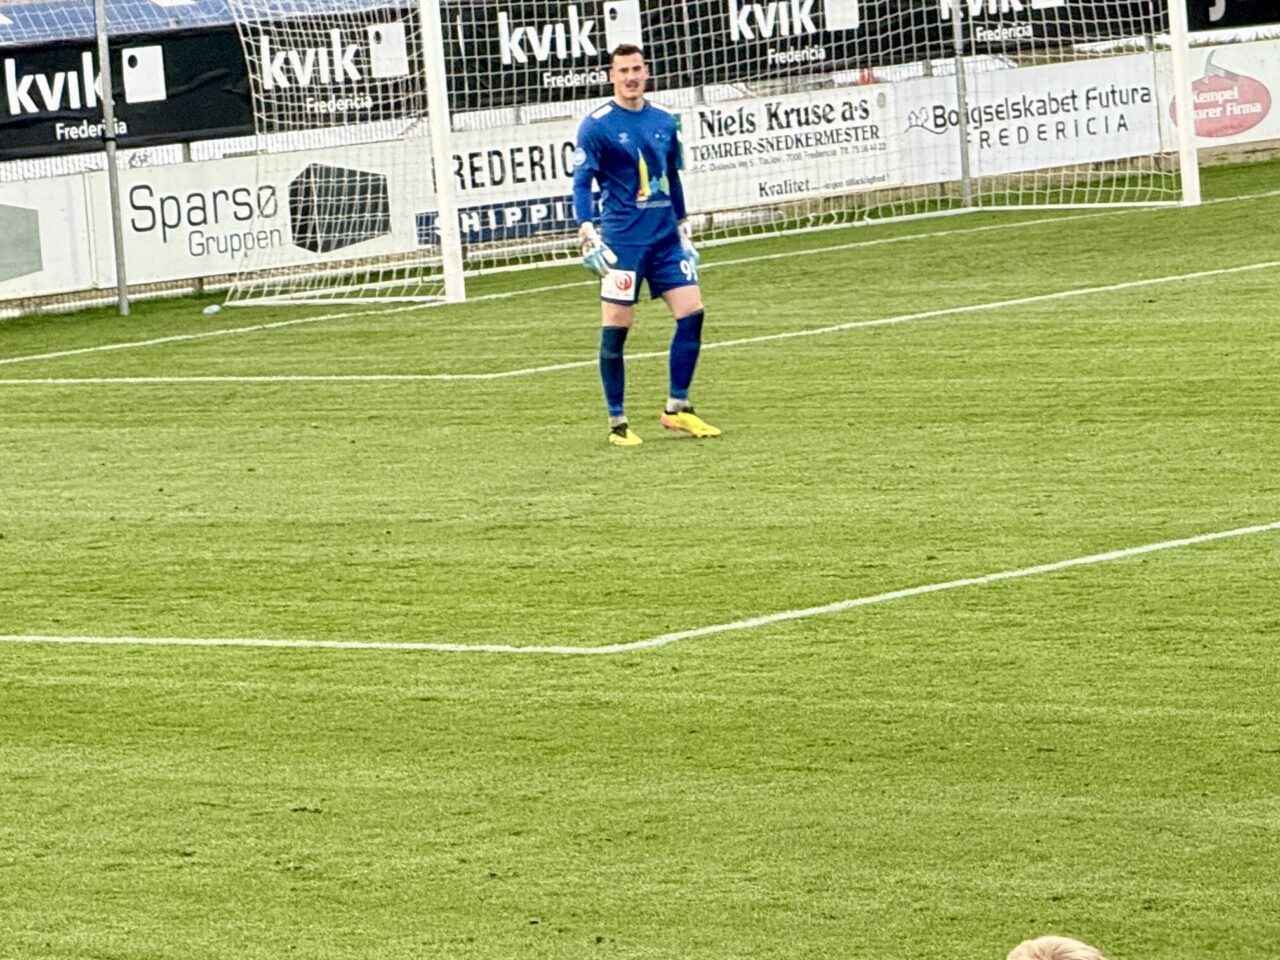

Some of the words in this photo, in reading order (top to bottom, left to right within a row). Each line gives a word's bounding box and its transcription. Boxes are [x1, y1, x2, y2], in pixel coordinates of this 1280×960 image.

[498, 5, 598, 65] kvik
[730, 0, 818, 41] kvik
[976, 22, 1032, 42] Fredericia
[260, 28, 362, 90] kvik
[768, 44, 826, 65] Fredericia
[4, 51, 115, 115] kvik
[543, 69, 608, 88] Fredericia
[306, 93, 373, 114] Fredericia
[698, 106, 757, 139] Niels
[764, 101, 835, 132] Kruse
[932, 89, 1079, 130] Boigselskabet
[1085, 84, 1152, 111] Futura
[1226, 102, 1263, 116] Firma
[55, 118, 128, 141] Frederiia
[690, 124, 881, 162] TØMRER-SNEDKERMESTER
[965, 113, 1129, 149] REDERICIA
[758, 178, 811, 198] Kvalitet
[129, 184, 278, 244] Sparsø
[188, 228, 282, 260] Gruppen
